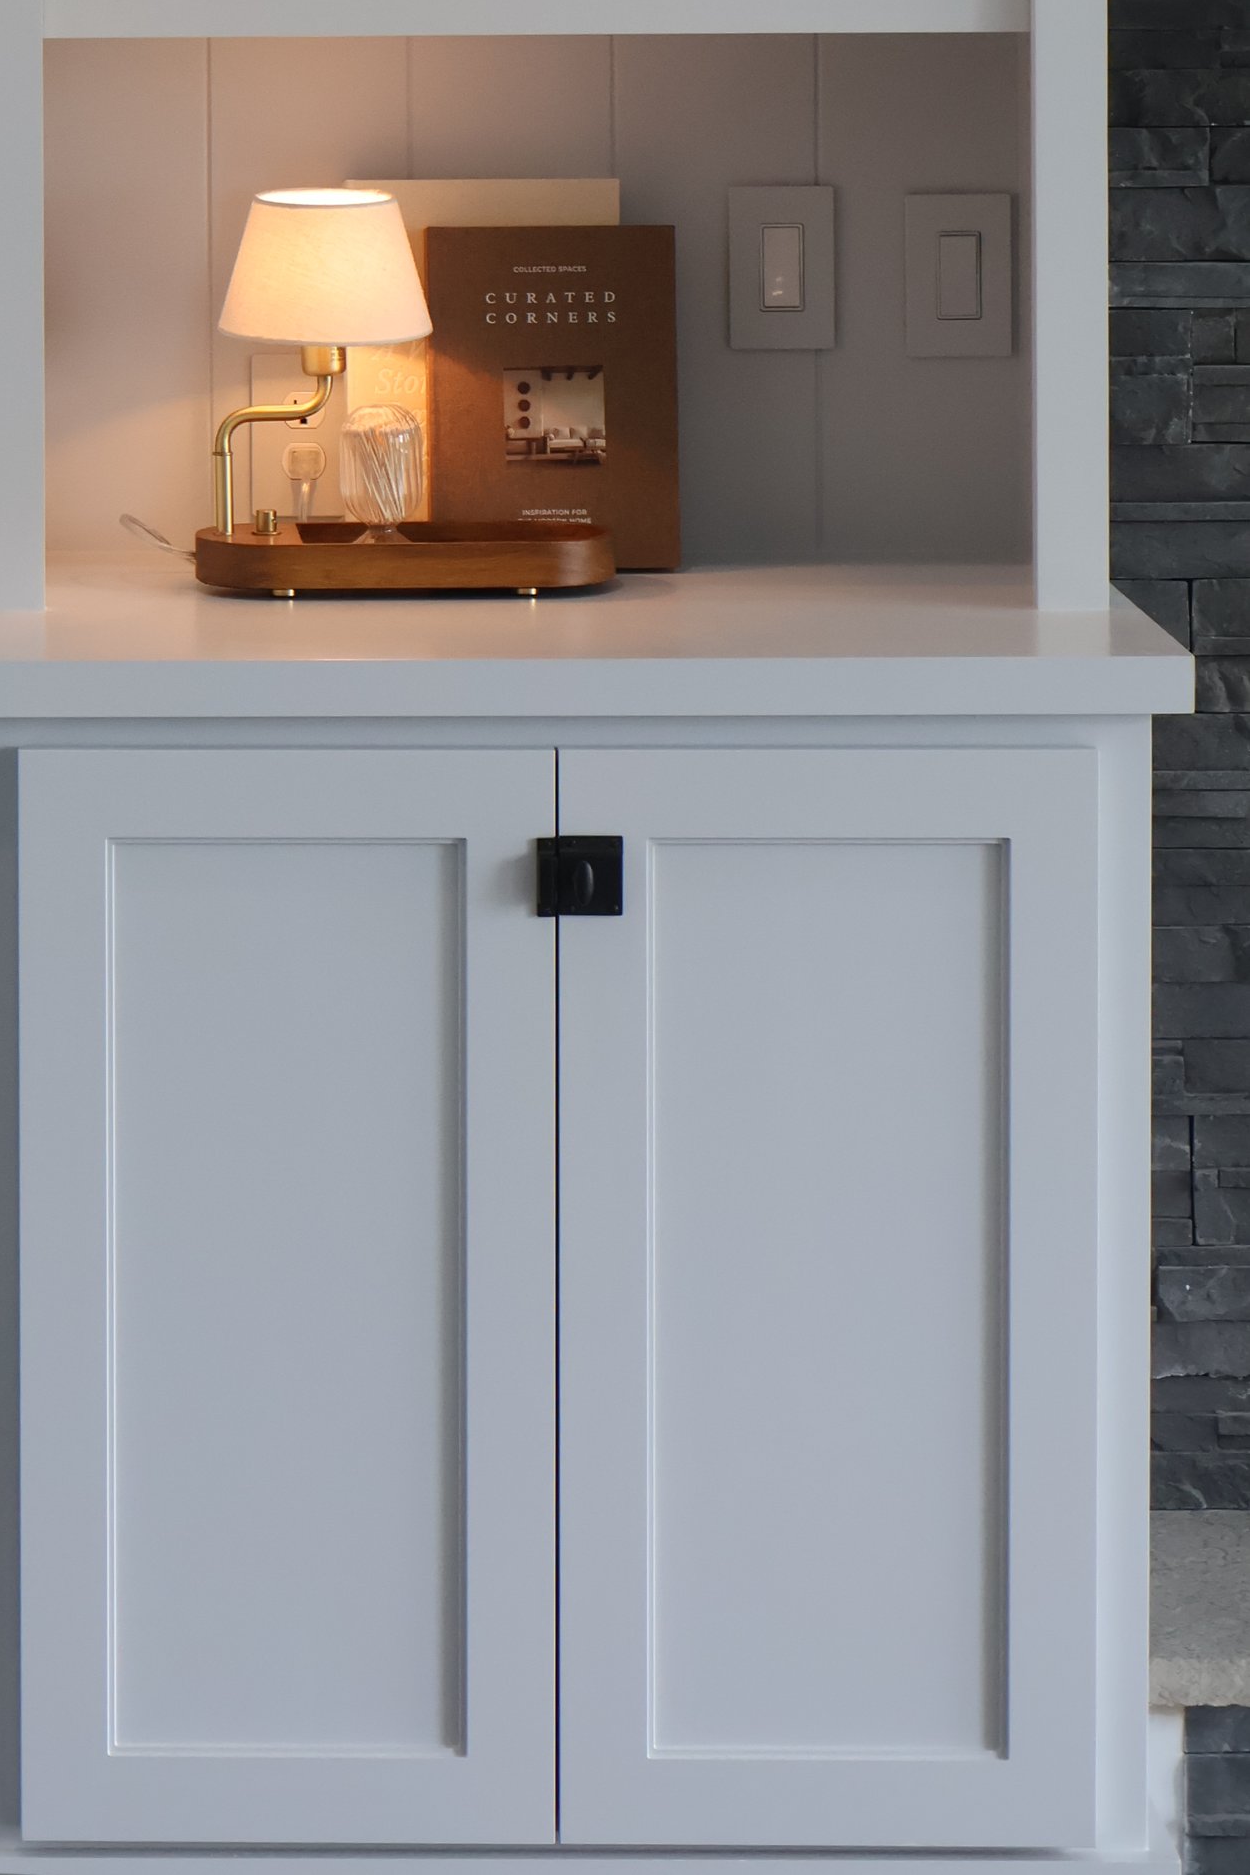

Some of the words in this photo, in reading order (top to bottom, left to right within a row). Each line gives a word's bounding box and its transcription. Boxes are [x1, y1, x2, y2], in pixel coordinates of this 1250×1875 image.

[513, 265, 557, 273] COLLECTED
[558, 265, 587, 273] SPACES
[485, 291, 617, 304] CURATED
[485, 311, 617, 325] CORNERS
